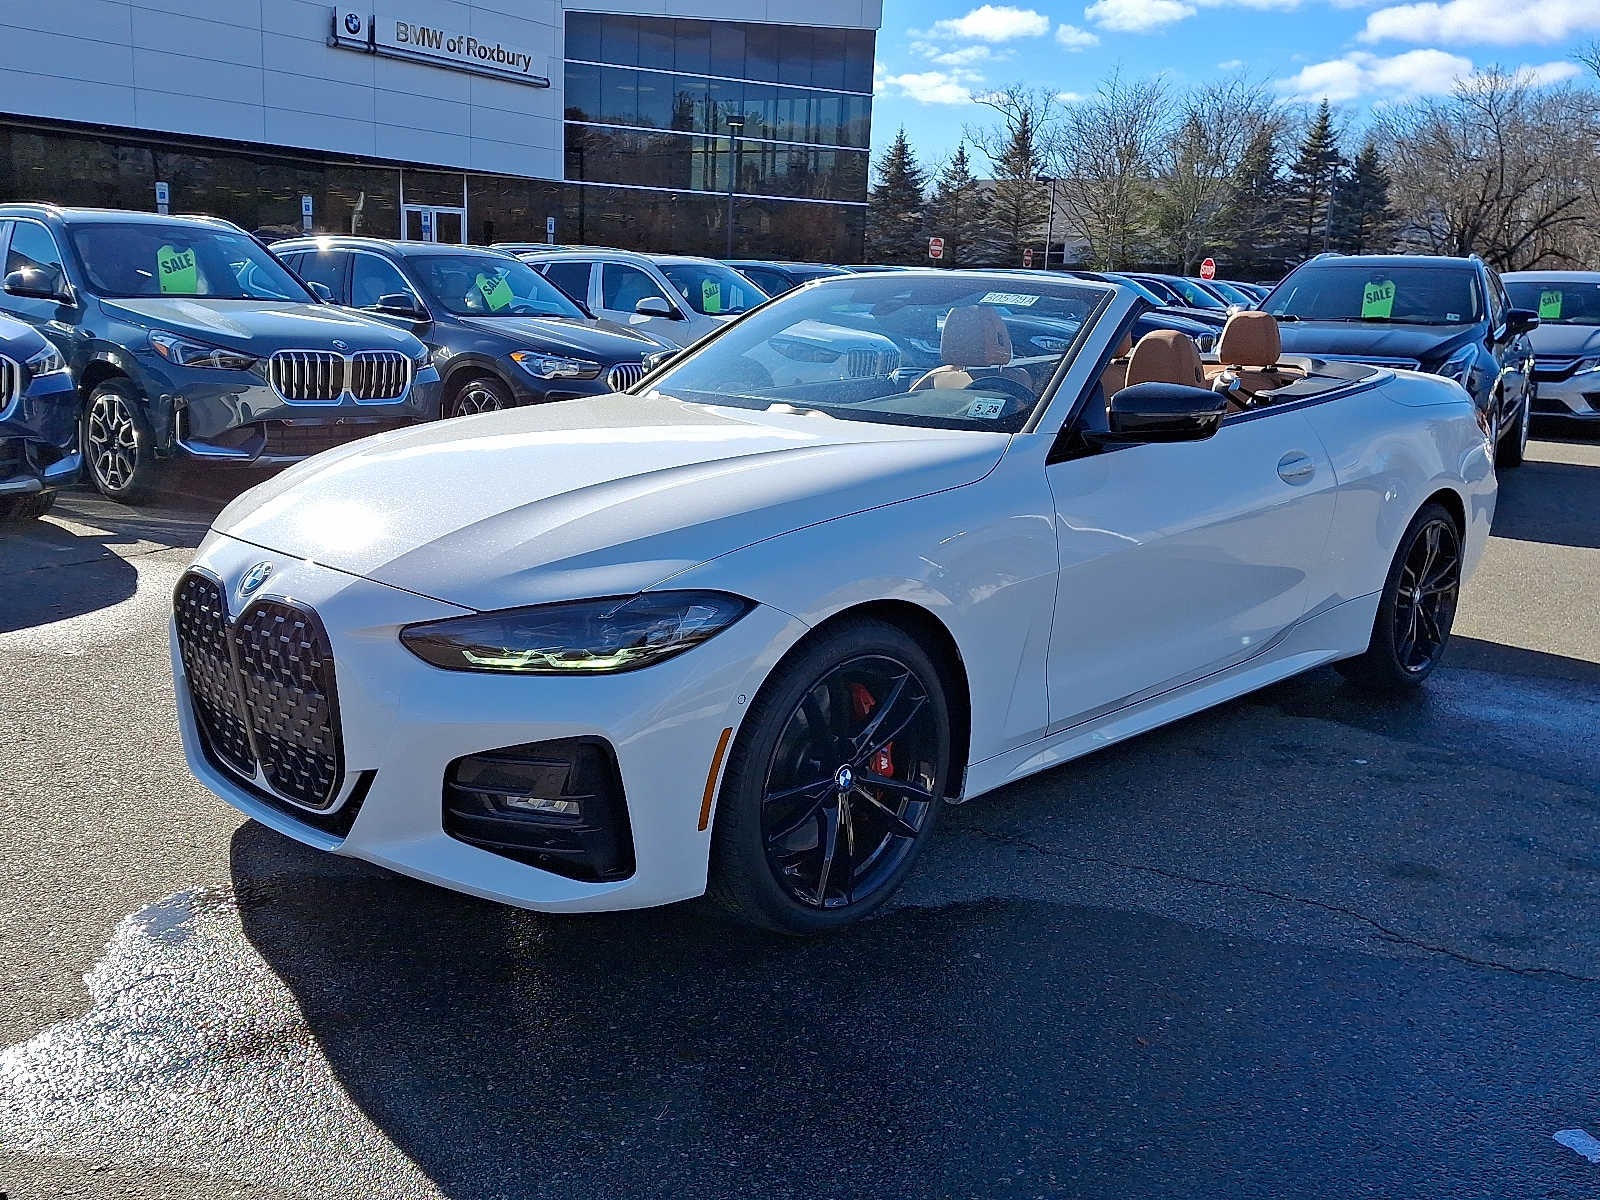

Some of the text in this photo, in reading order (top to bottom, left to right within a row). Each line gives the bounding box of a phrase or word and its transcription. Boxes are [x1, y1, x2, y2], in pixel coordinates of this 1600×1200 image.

[396, 21, 532, 72] BMW of Roxbury
[161, 253, 193, 274] SALE
[704, 284, 719, 299] SALE
[1366, 287, 1392, 304] SALE
[1542, 295, 1560, 306] SALE
[974, 404, 983, 412] 5
[986, 404, 1000, 414] 28
